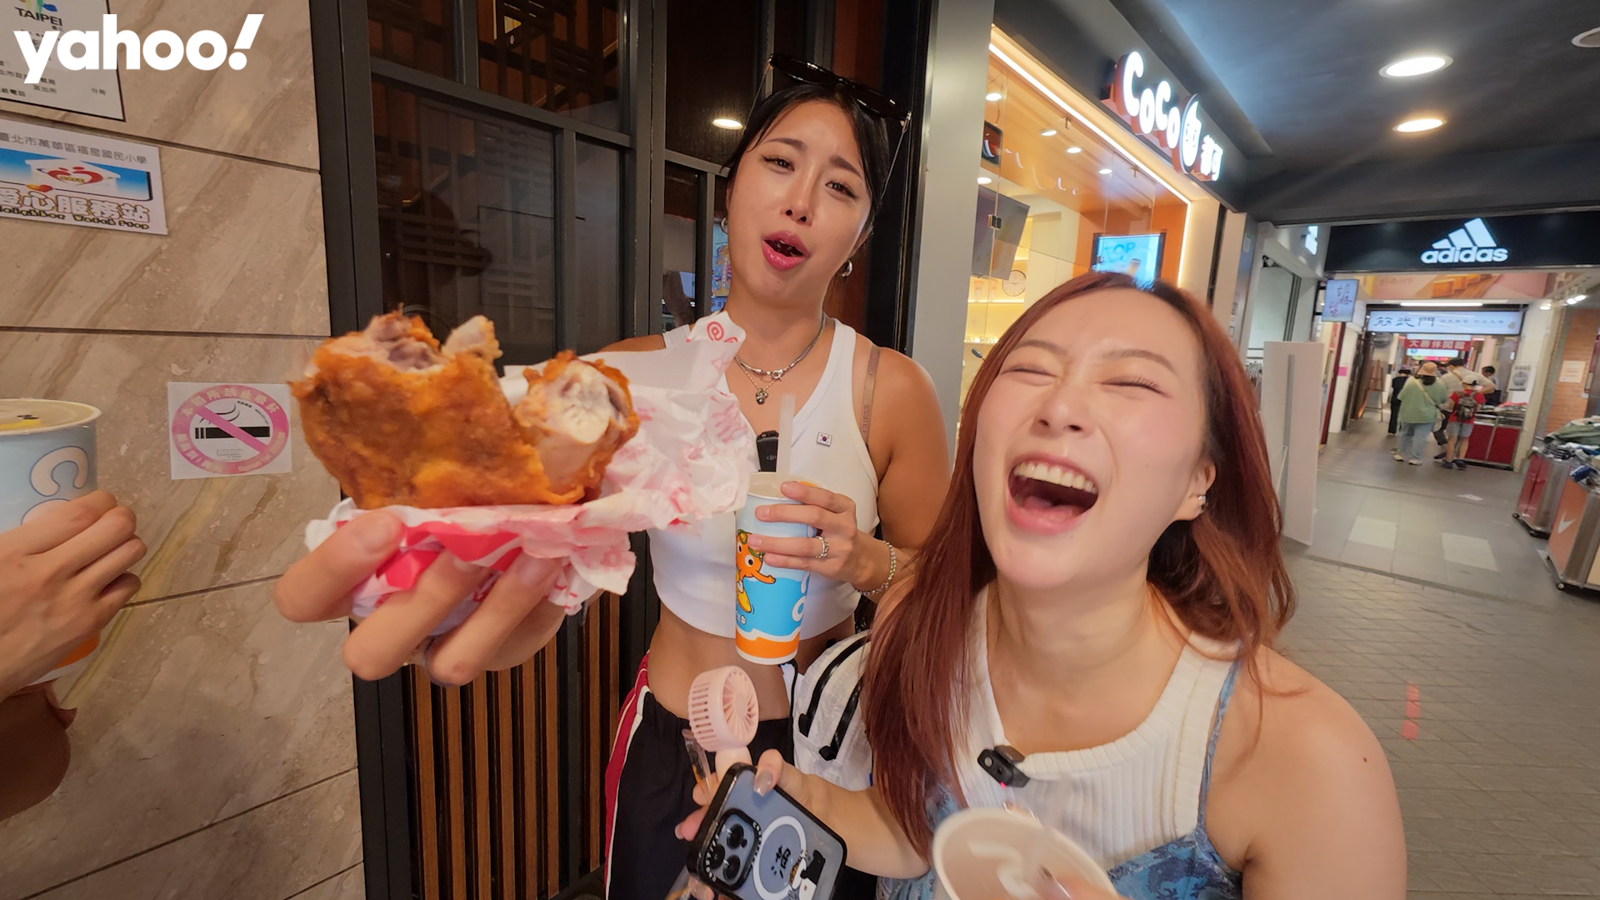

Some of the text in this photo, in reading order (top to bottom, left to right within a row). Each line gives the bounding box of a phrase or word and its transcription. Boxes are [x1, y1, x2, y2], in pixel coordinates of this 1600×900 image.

[14, 6, 63, 26] TAIPEI
[73, 214, 116, 226] Watch
[118, 220, 149, 230] Stop
[1420, 245, 1509, 264] adidas
